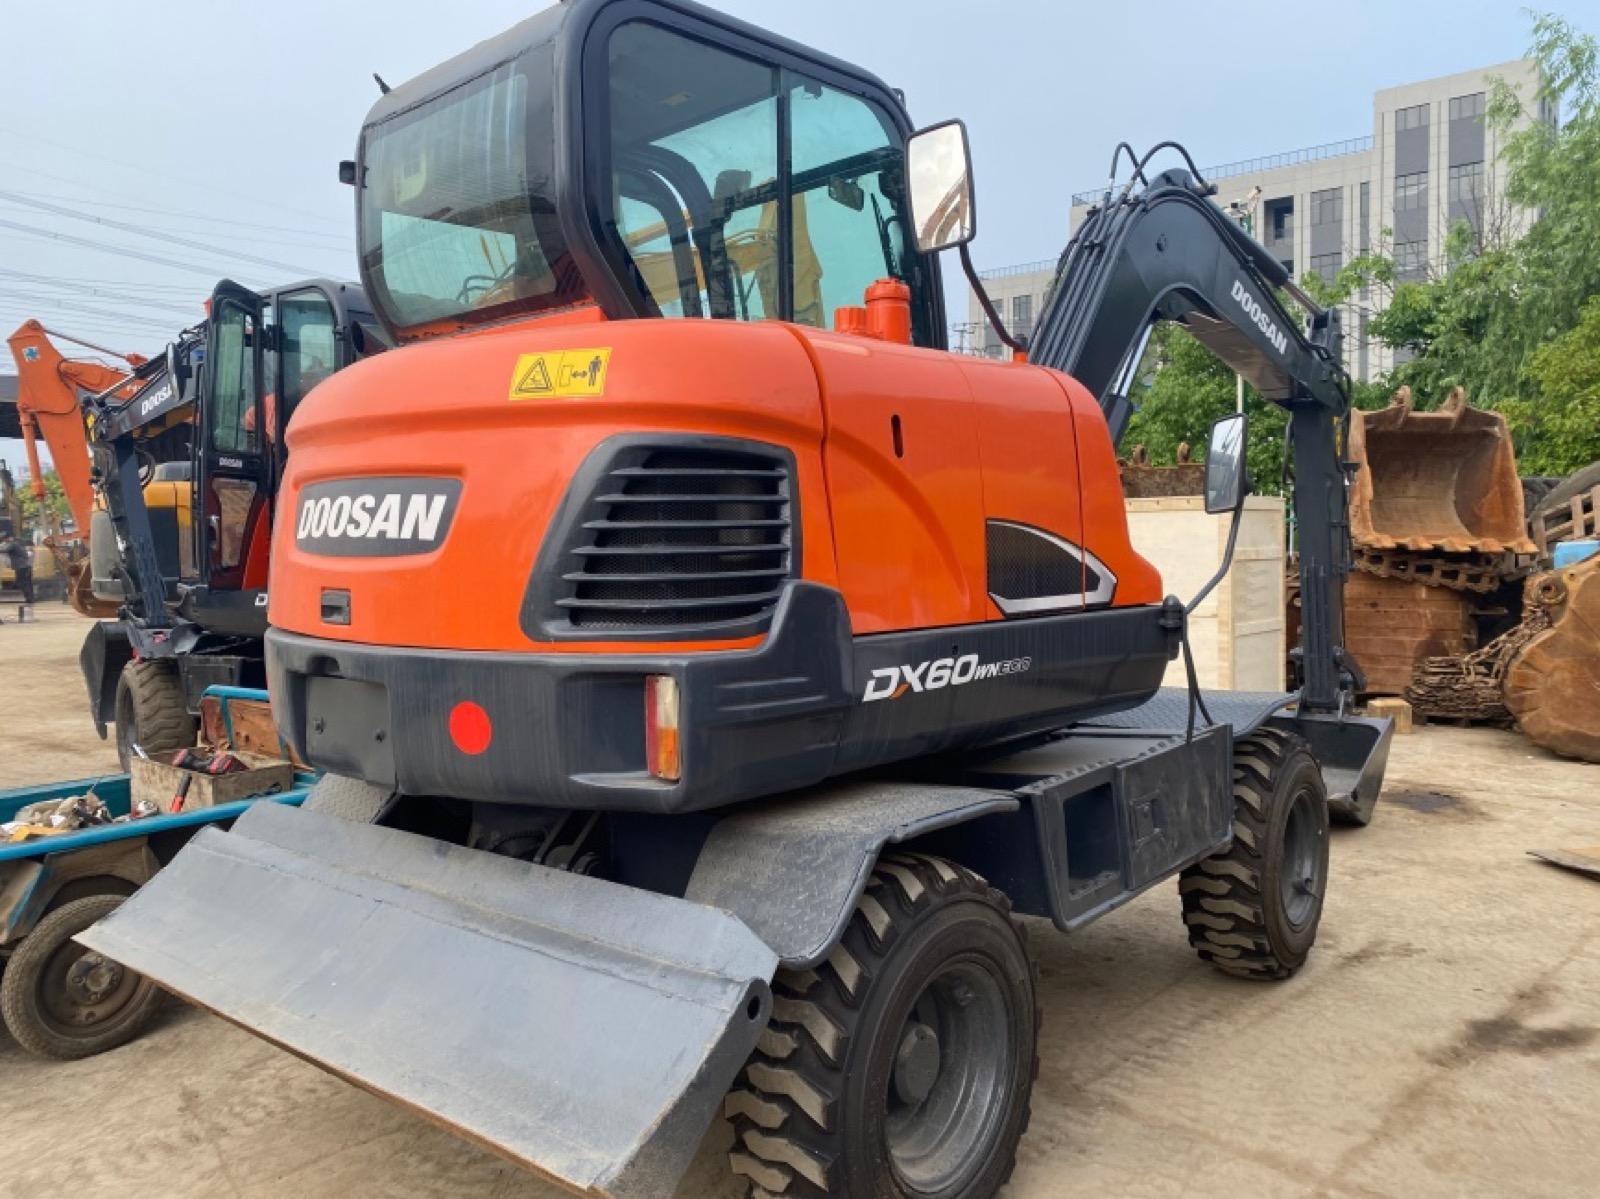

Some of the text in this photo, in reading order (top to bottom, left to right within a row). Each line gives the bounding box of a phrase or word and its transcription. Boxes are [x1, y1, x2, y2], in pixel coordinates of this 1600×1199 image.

[1231, 280, 1287, 354] DOOSAN
[141, 383, 172, 415] DOOSA
[297, 494, 447, 541] DOOSAN
